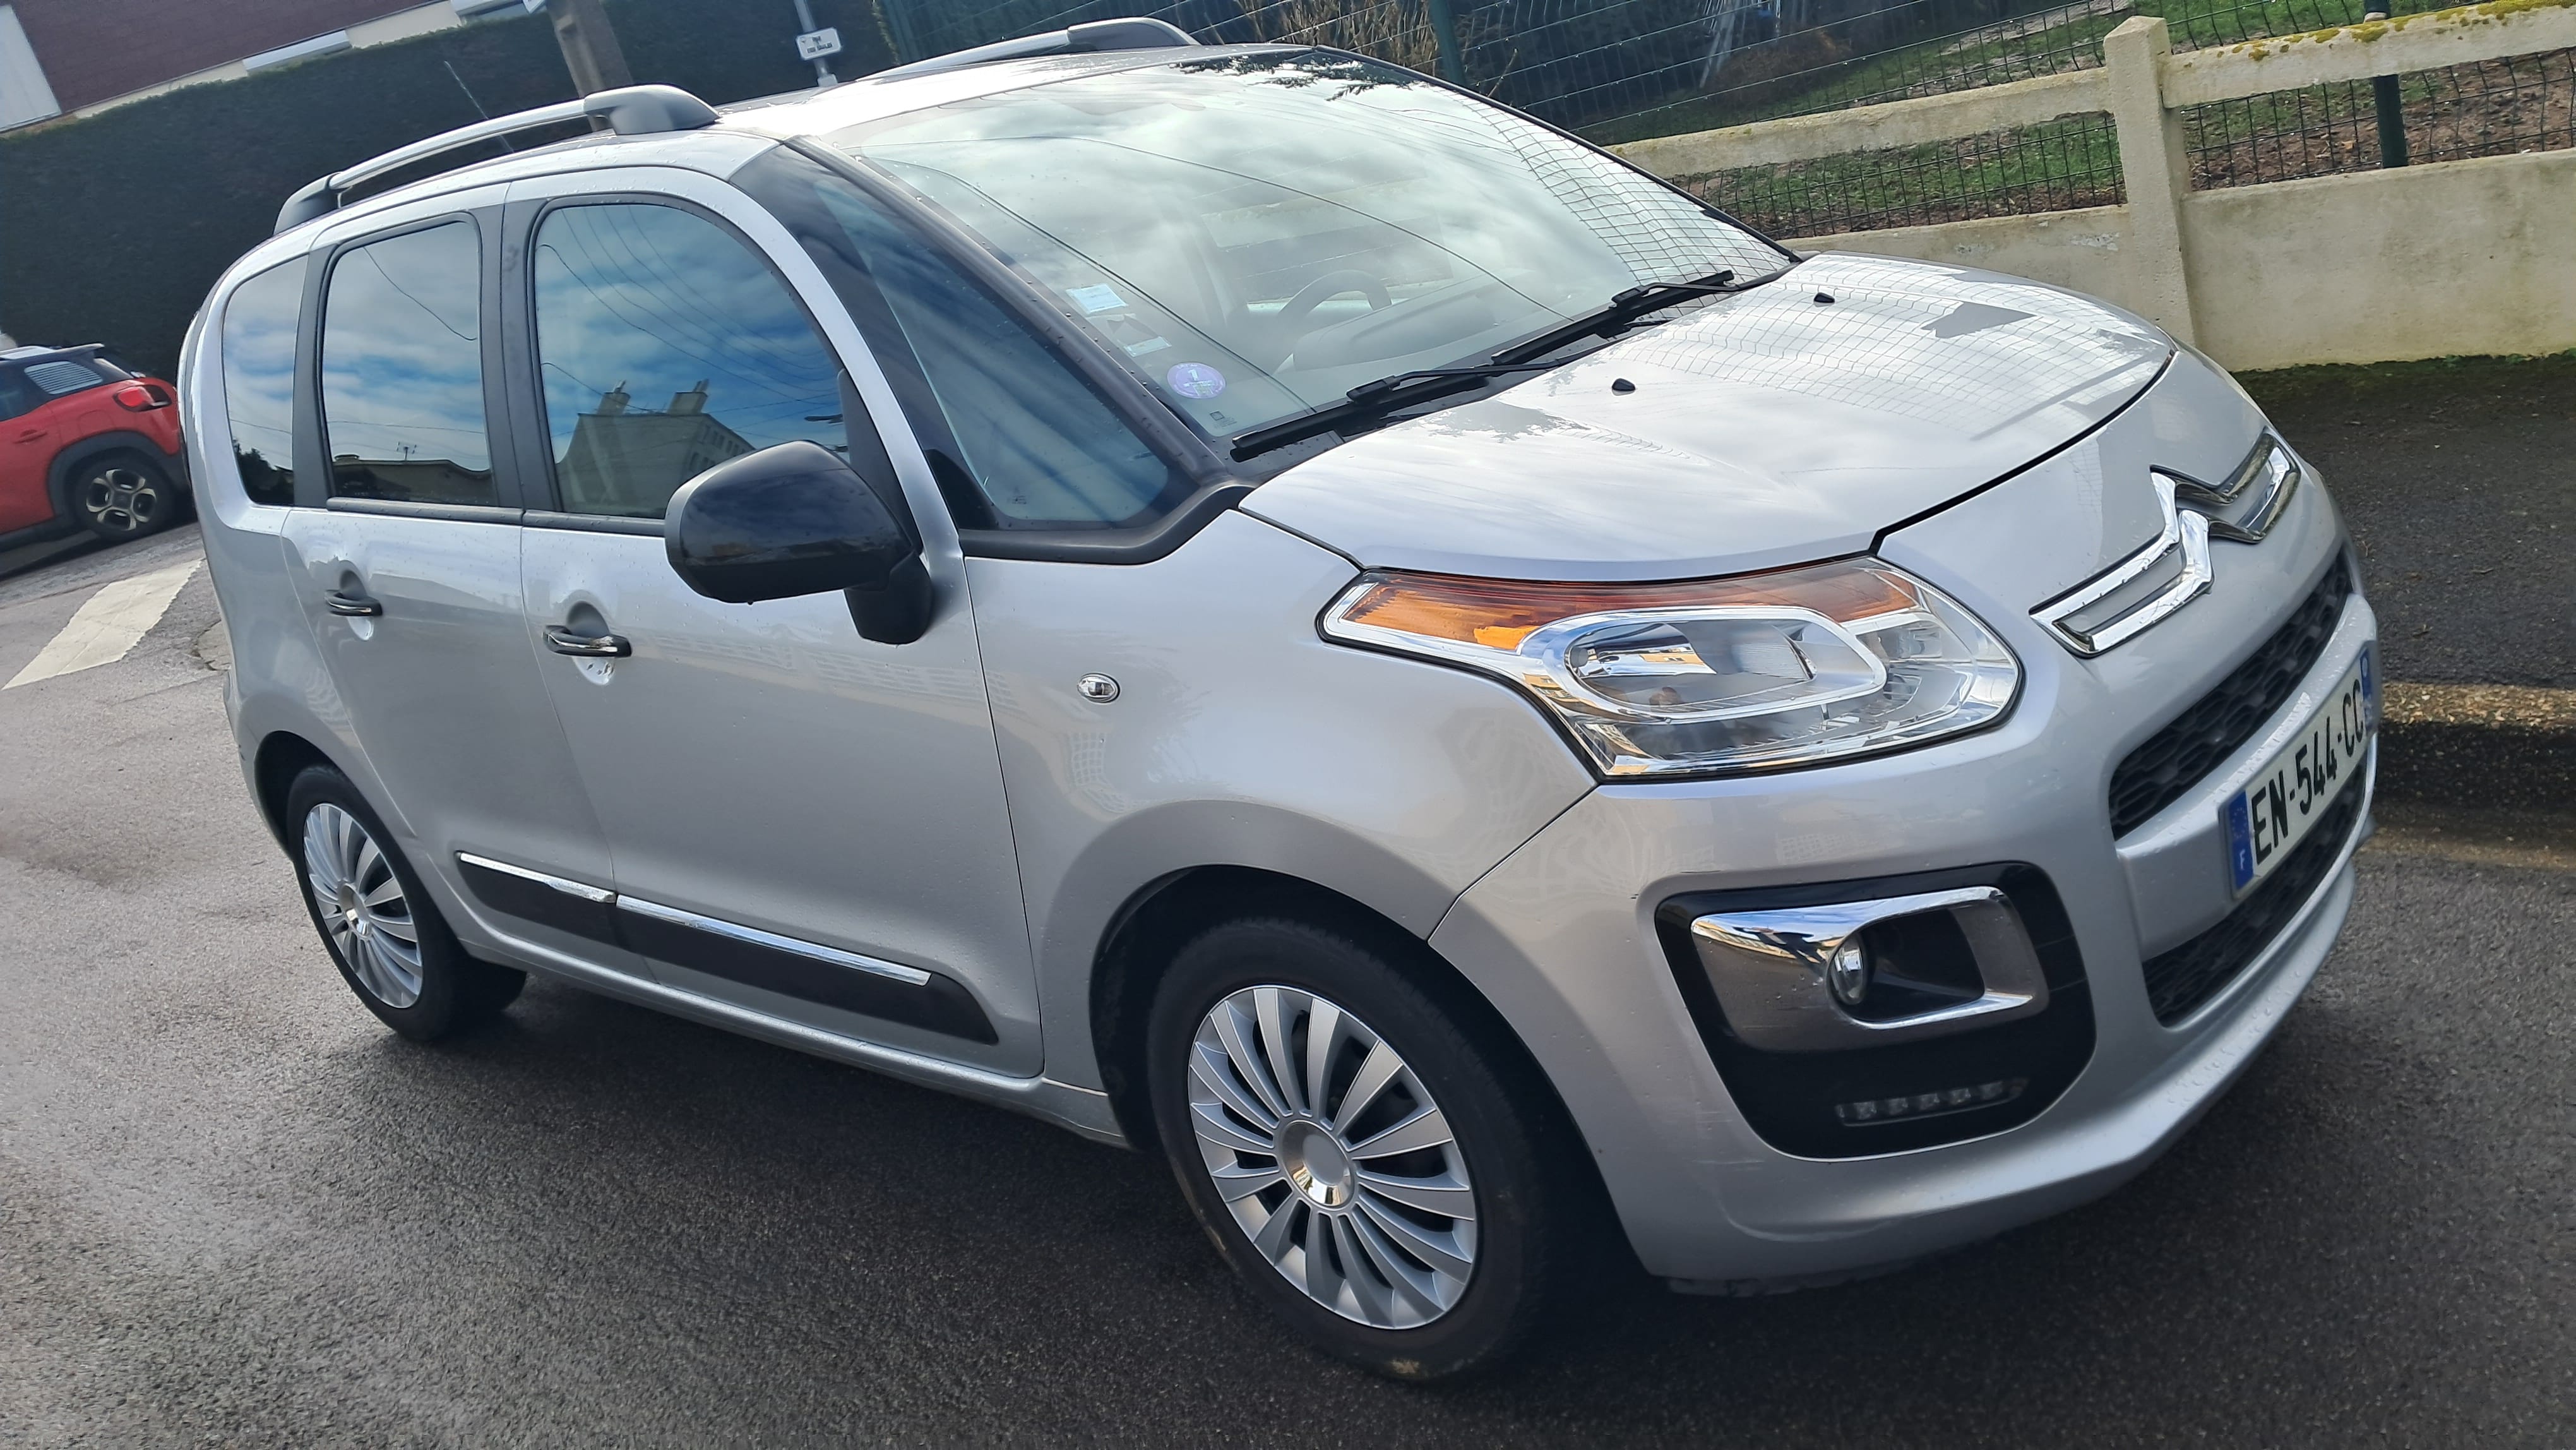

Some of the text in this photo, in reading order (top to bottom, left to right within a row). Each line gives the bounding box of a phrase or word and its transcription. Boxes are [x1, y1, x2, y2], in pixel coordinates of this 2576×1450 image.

[1188, 369, 1198, 381] 1
[2251, 679, 2364, 865] EN-544-CC
[2239, 849, 2246, 870] F
